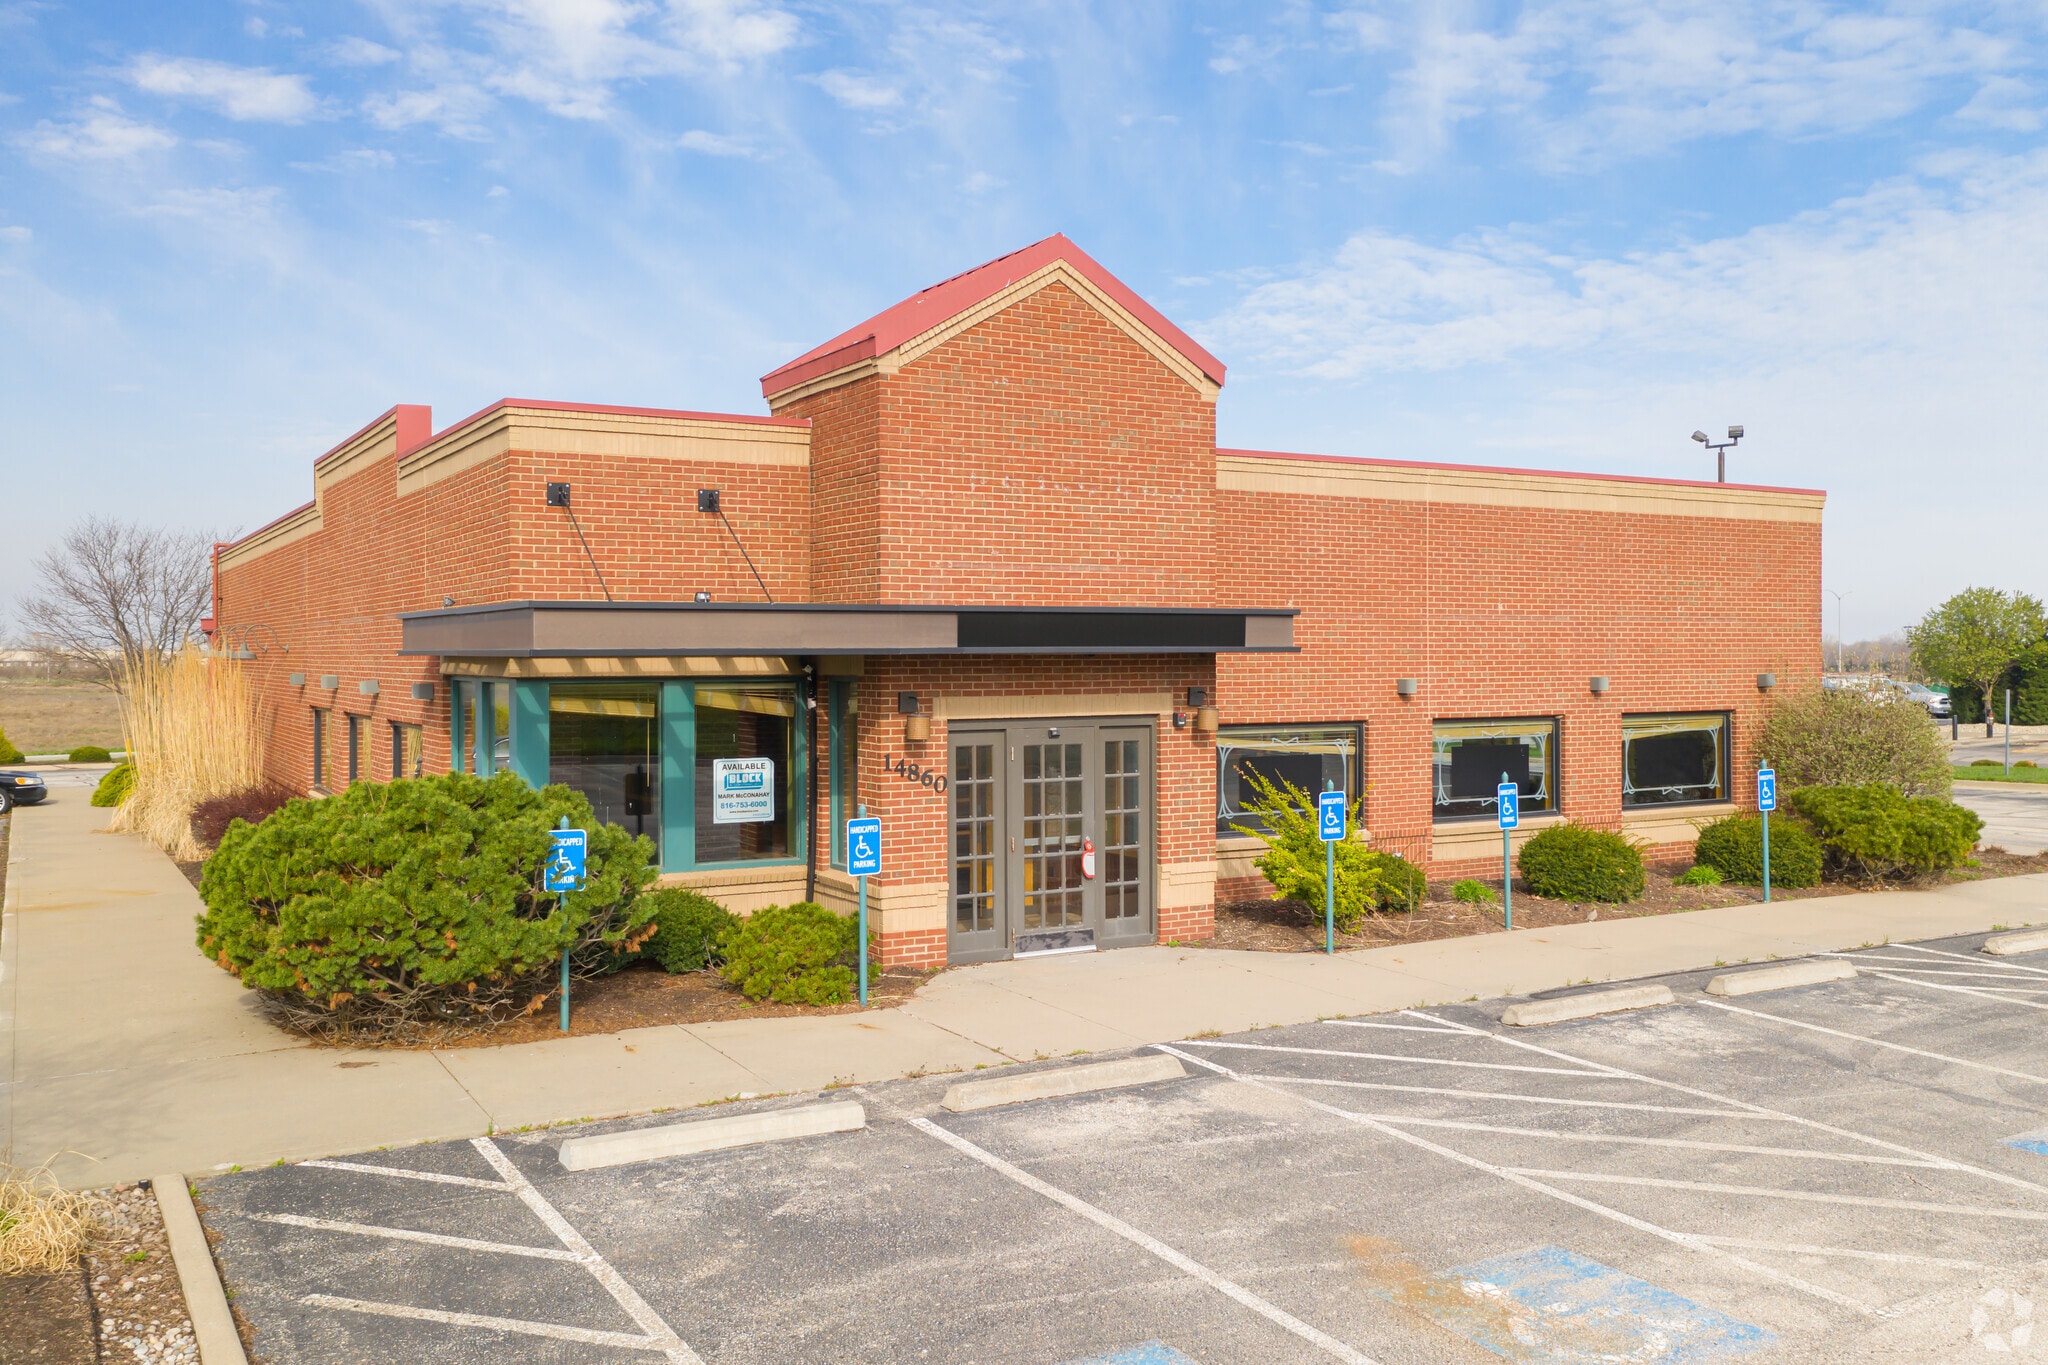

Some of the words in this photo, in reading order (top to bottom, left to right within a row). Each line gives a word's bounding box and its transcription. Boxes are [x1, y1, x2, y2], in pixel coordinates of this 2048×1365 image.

[722, 762, 766, 770] AVAILABLE
[883, 753, 948, 793] 14860
[729, 773, 761, 783] BLOCK
[720, 801, 768, 809] 816-753-6000
[853, 860, 875, 868] PARKING
